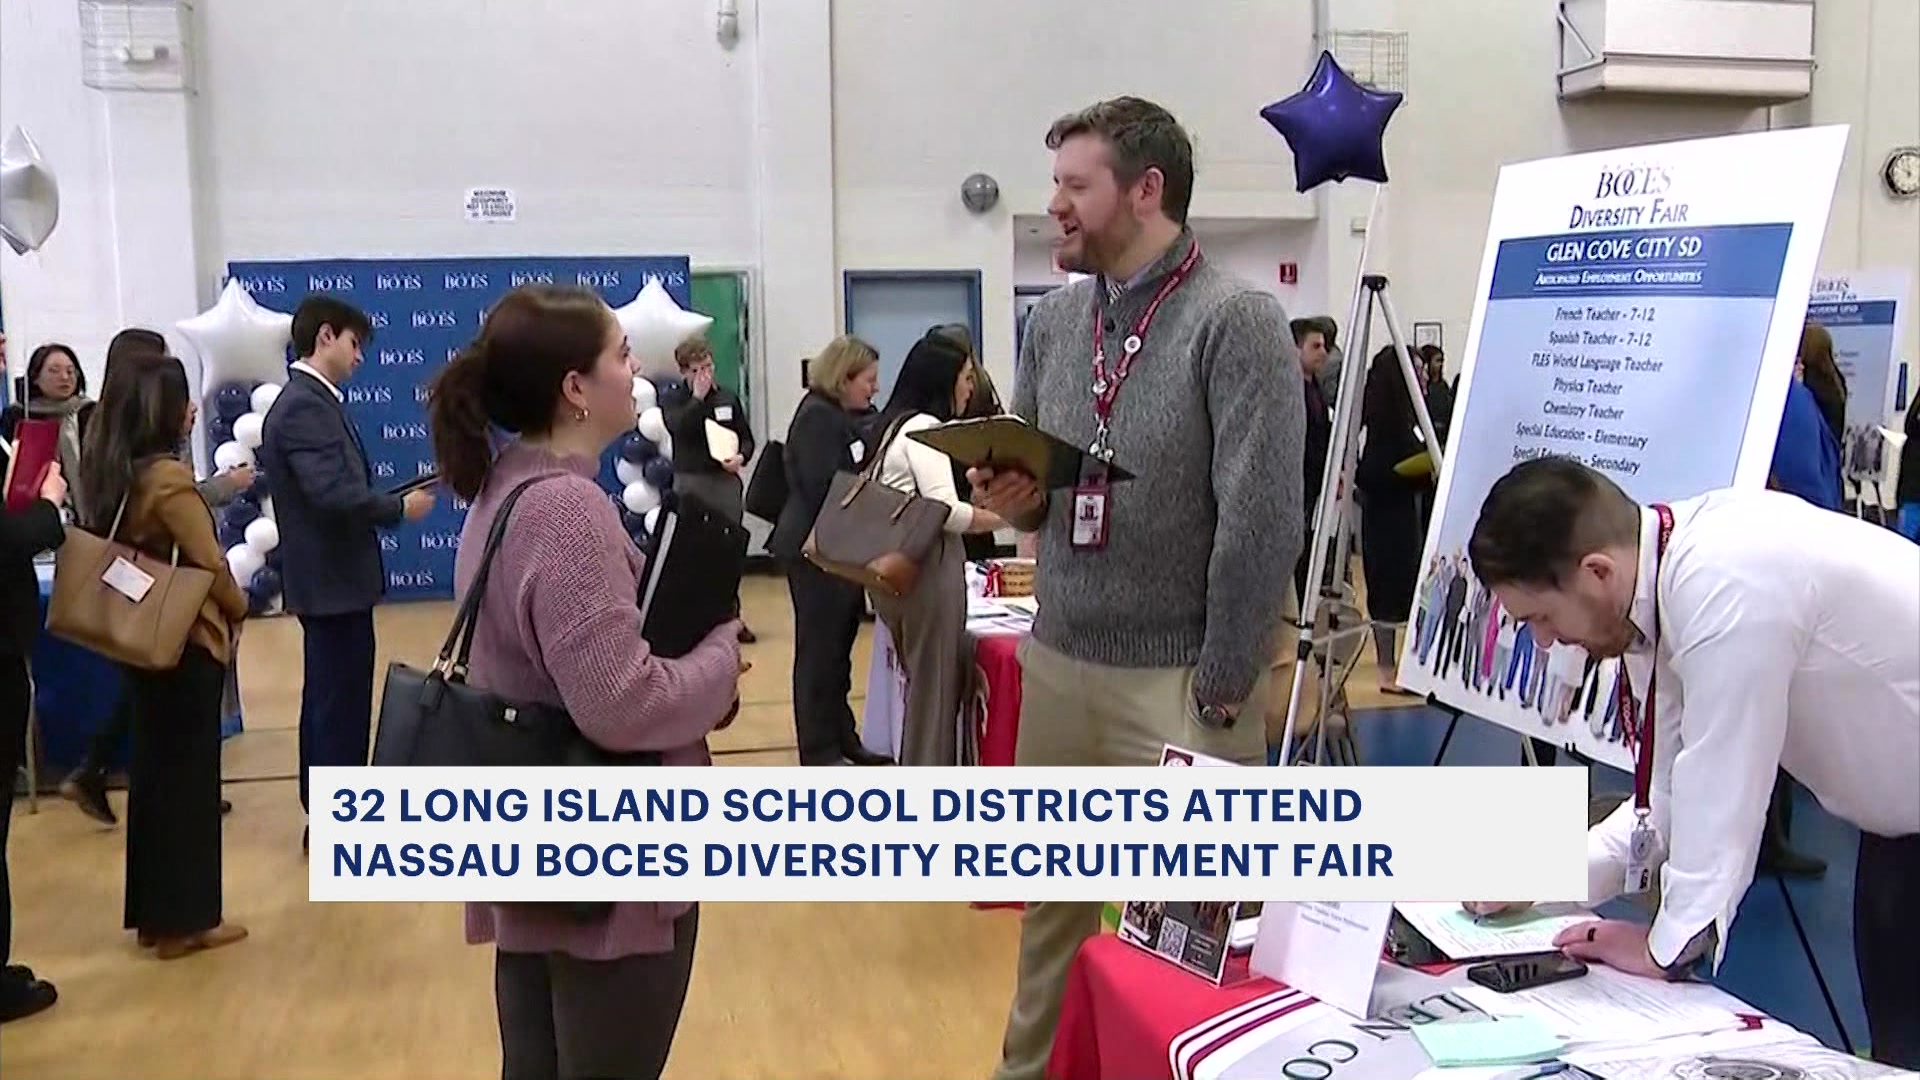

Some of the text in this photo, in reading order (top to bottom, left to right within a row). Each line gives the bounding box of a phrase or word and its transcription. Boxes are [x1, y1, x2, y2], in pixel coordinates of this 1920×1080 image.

[1595, 167, 1673, 199] BOCES
[1569, 198, 1689, 229] DIVERSITY FAIR
[1546, 235, 1702, 262] GLEN COVE CITY SD
[1555, 306, 1583, 321] French
[1586, 306, 1621, 321] Teacher
[1629, 307, 1656, 322] 7-12
[1549, 330, 1580, 347] Spanish
[1583, 331, 1618, 345] Teacher
[1626, 332, 1652, 347] 7-12
[1552, 353, 1579, 368] World
[1580, 354, 1622, 373] Language
[1624, 356, 1664, 373] Teacher
[1553, 376, 1623, 395] Physics Teacher
[1543, 400, 1624, 420] Chemistry Teacher
[1515, 421, 1543, 438] Special
[1544, 424, 1586, 442] Education
[1595, 429, 1649, 451] Elementary
[1513, 445, 1540, 460] Special
[1591, 453, 1641, 475] Secondary
[1350, 993, 1498, 1041] LEN
